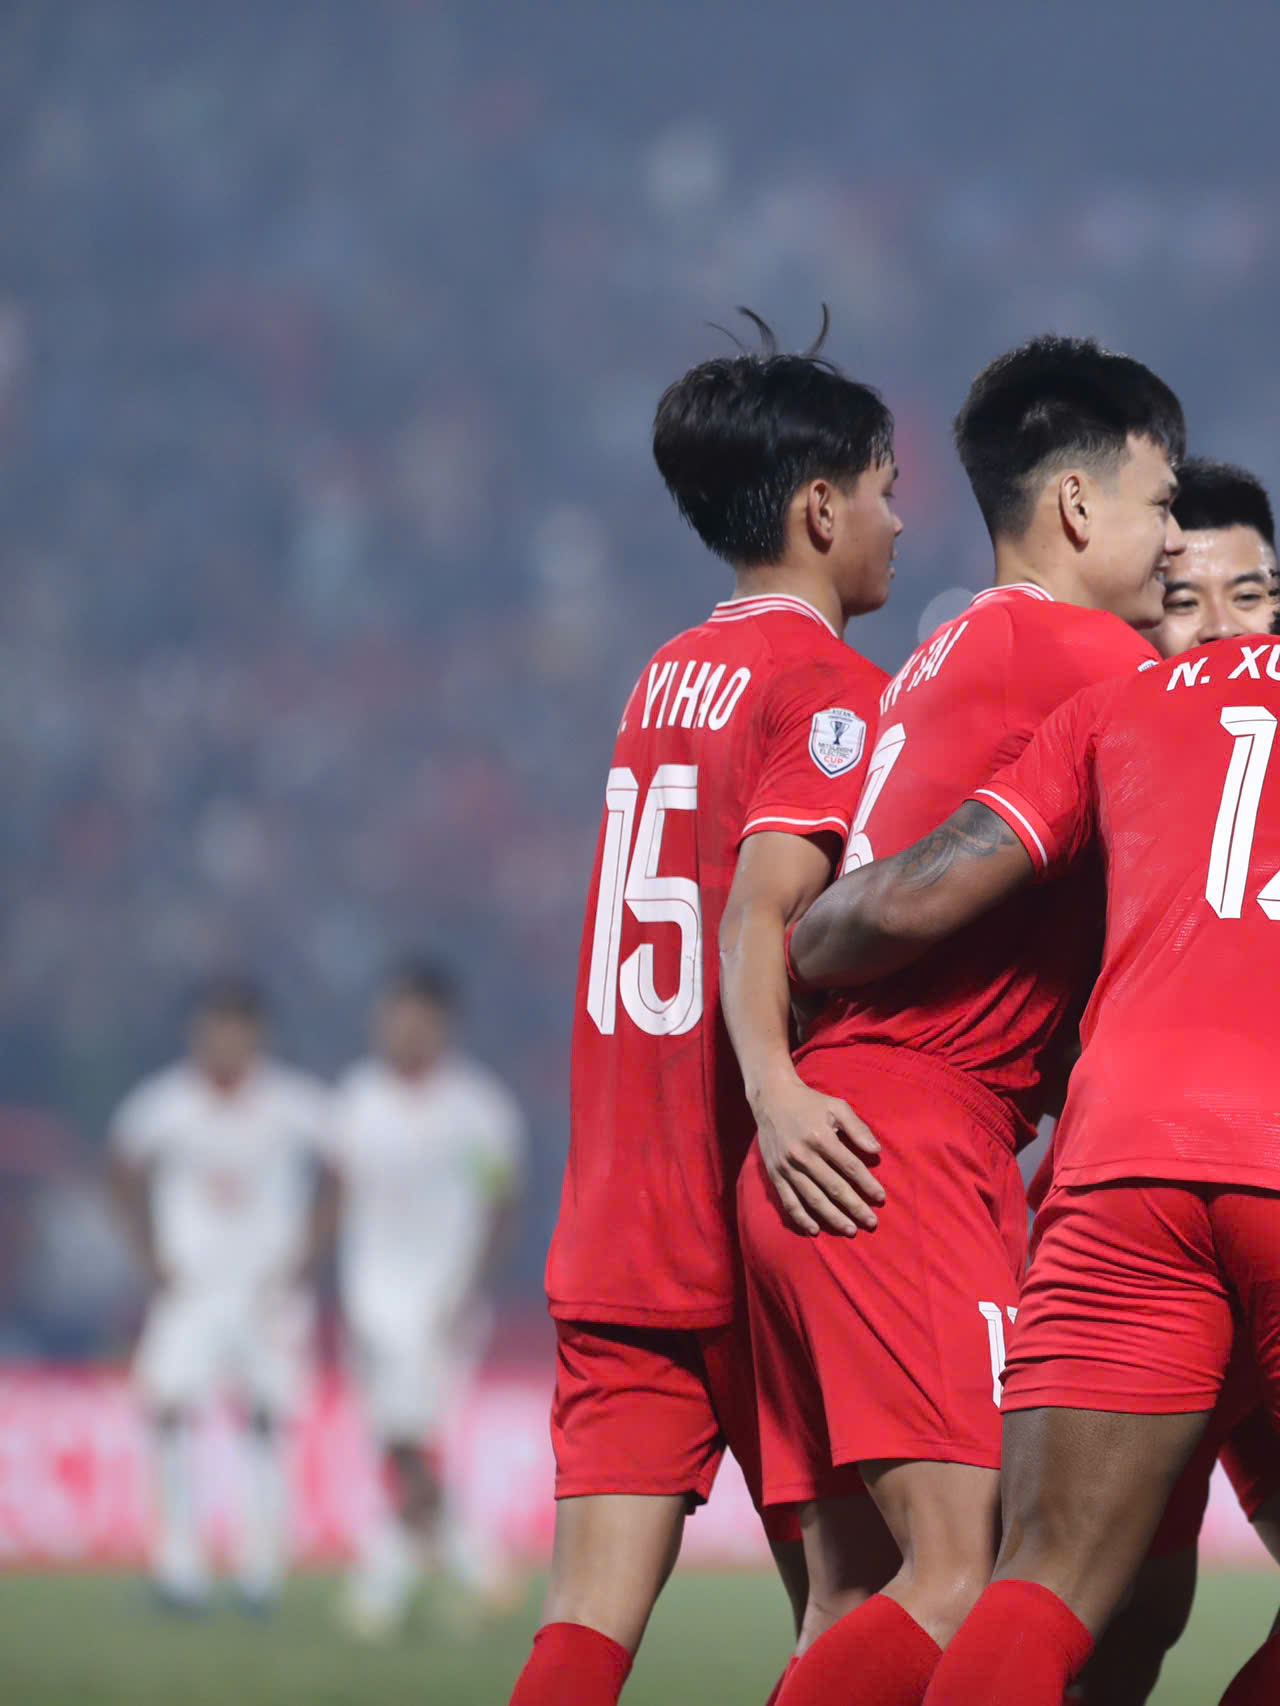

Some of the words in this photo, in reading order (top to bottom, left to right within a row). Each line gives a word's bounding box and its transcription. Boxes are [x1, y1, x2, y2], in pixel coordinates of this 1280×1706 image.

[1166, 657, 1211, 691] N.
[823, 755, 844, 765] CUP
[587, 764, 704, 1036] 15
[978, 1301, 1018, 1408] 1
